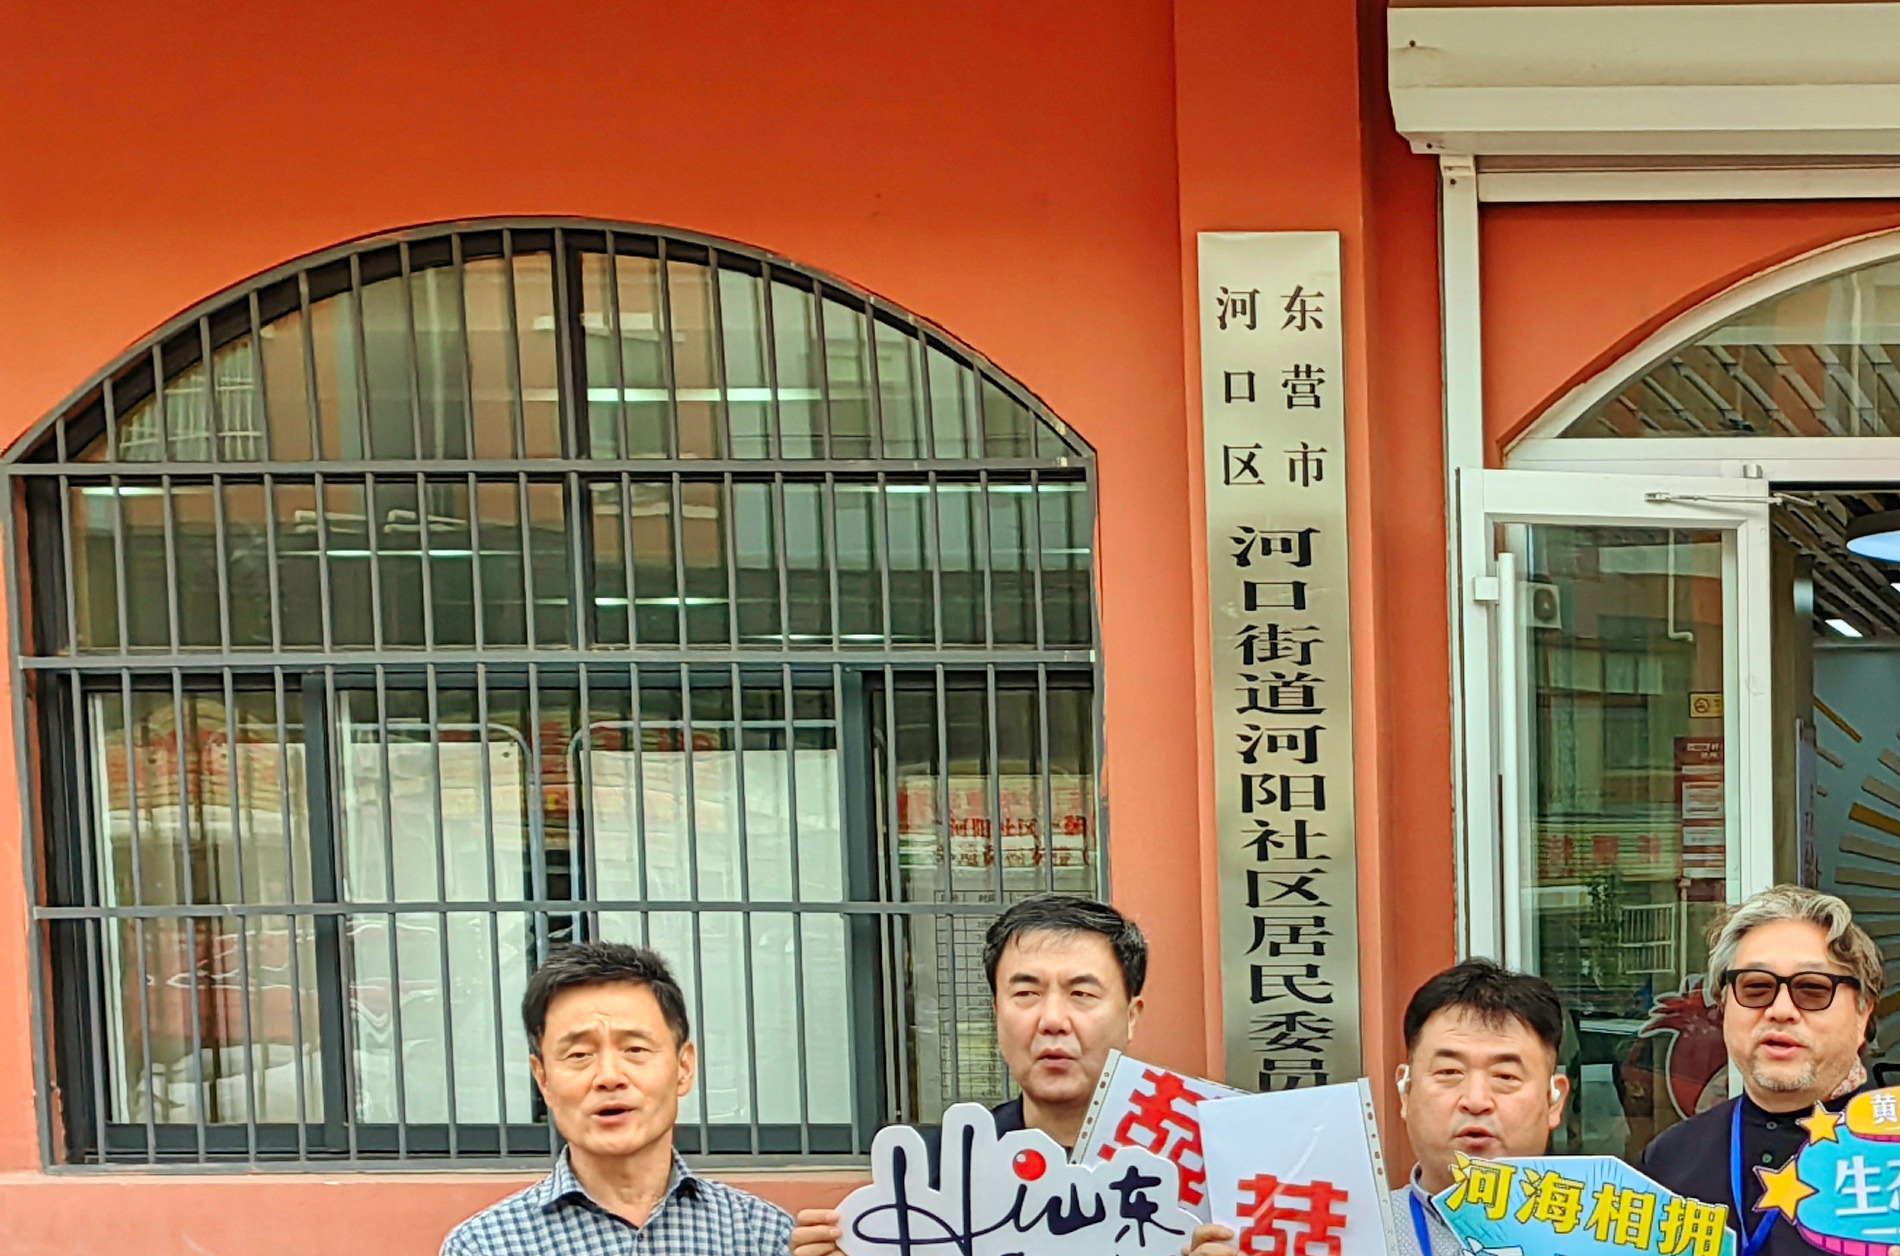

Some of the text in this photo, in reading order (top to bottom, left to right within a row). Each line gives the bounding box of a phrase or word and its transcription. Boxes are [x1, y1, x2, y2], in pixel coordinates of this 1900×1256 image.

[1216, 286, 1265, 486] 河口区
[1280, 285, 1328, 488] 东营市
